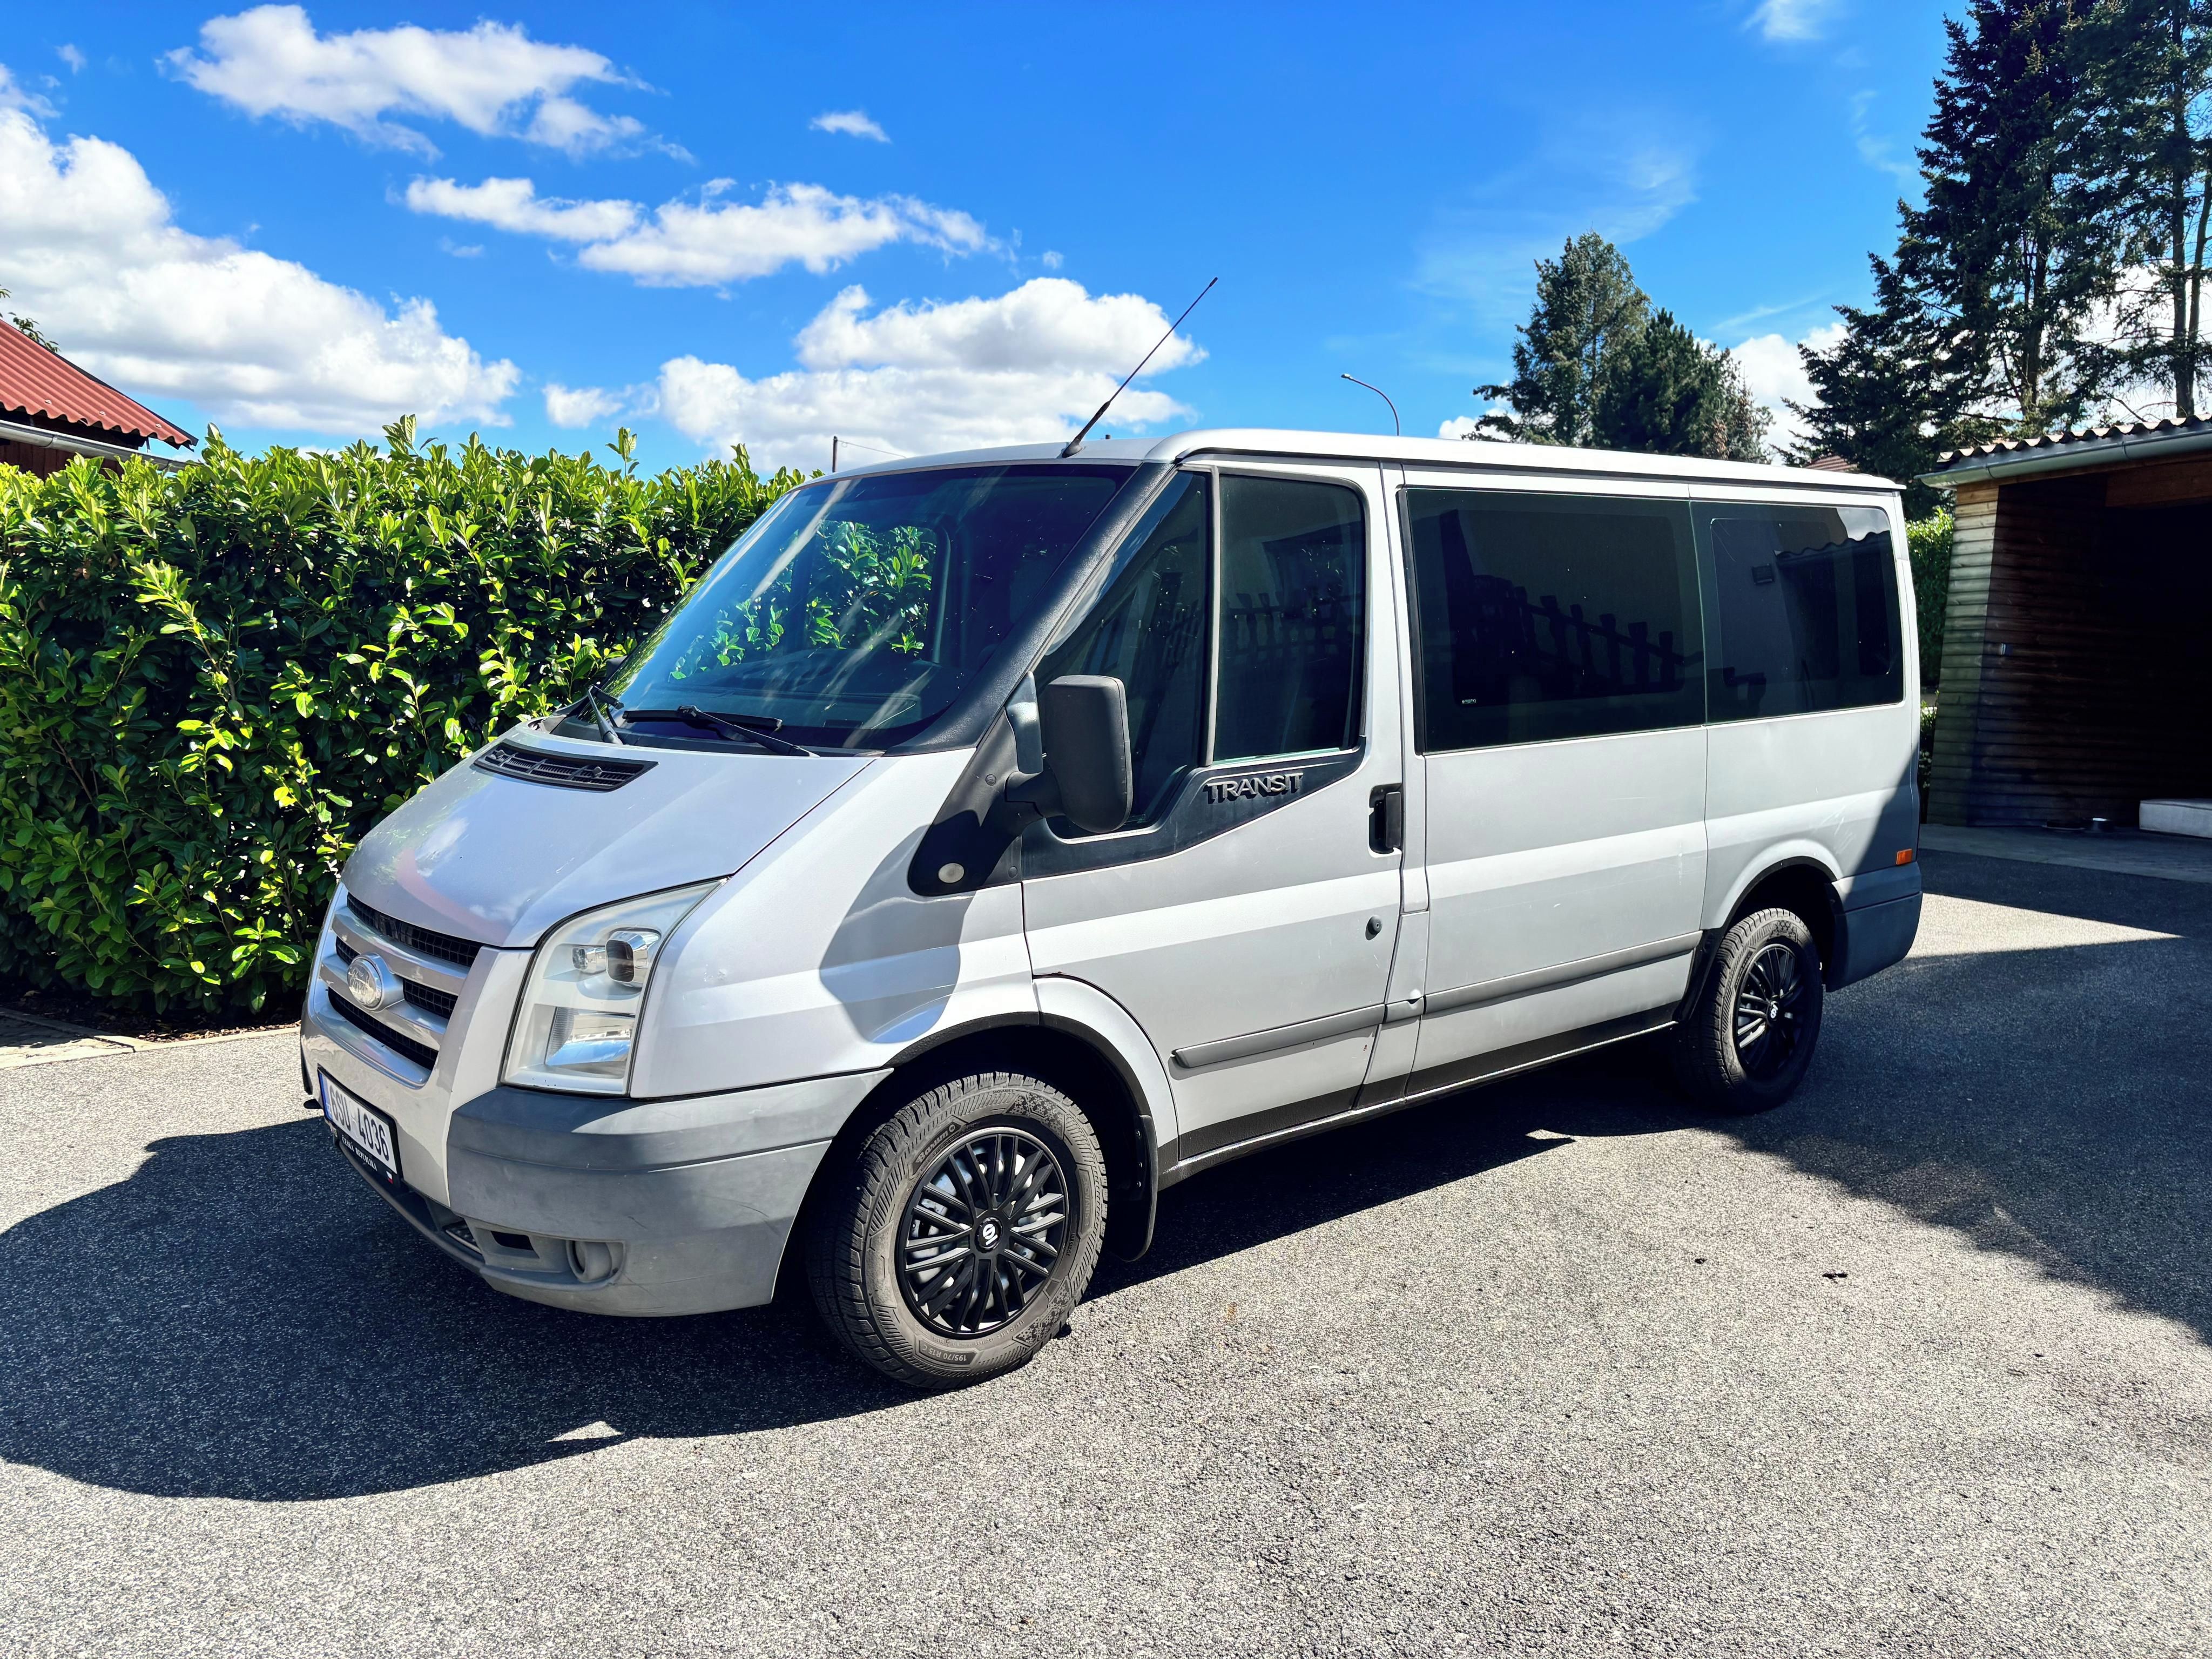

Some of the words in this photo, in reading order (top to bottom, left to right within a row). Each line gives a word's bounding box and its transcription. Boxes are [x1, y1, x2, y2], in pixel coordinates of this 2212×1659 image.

[1205, 772, 1304, 801] TRANSIT
[329, 1084, 352, 1132] 6SU
[357, 1107, 389, 1162] 4036
[915, 1130, 948, 1163] Barum
[928, 1348, 942, 1358] R15
[943, 1352, 967, 1361] 195/70
